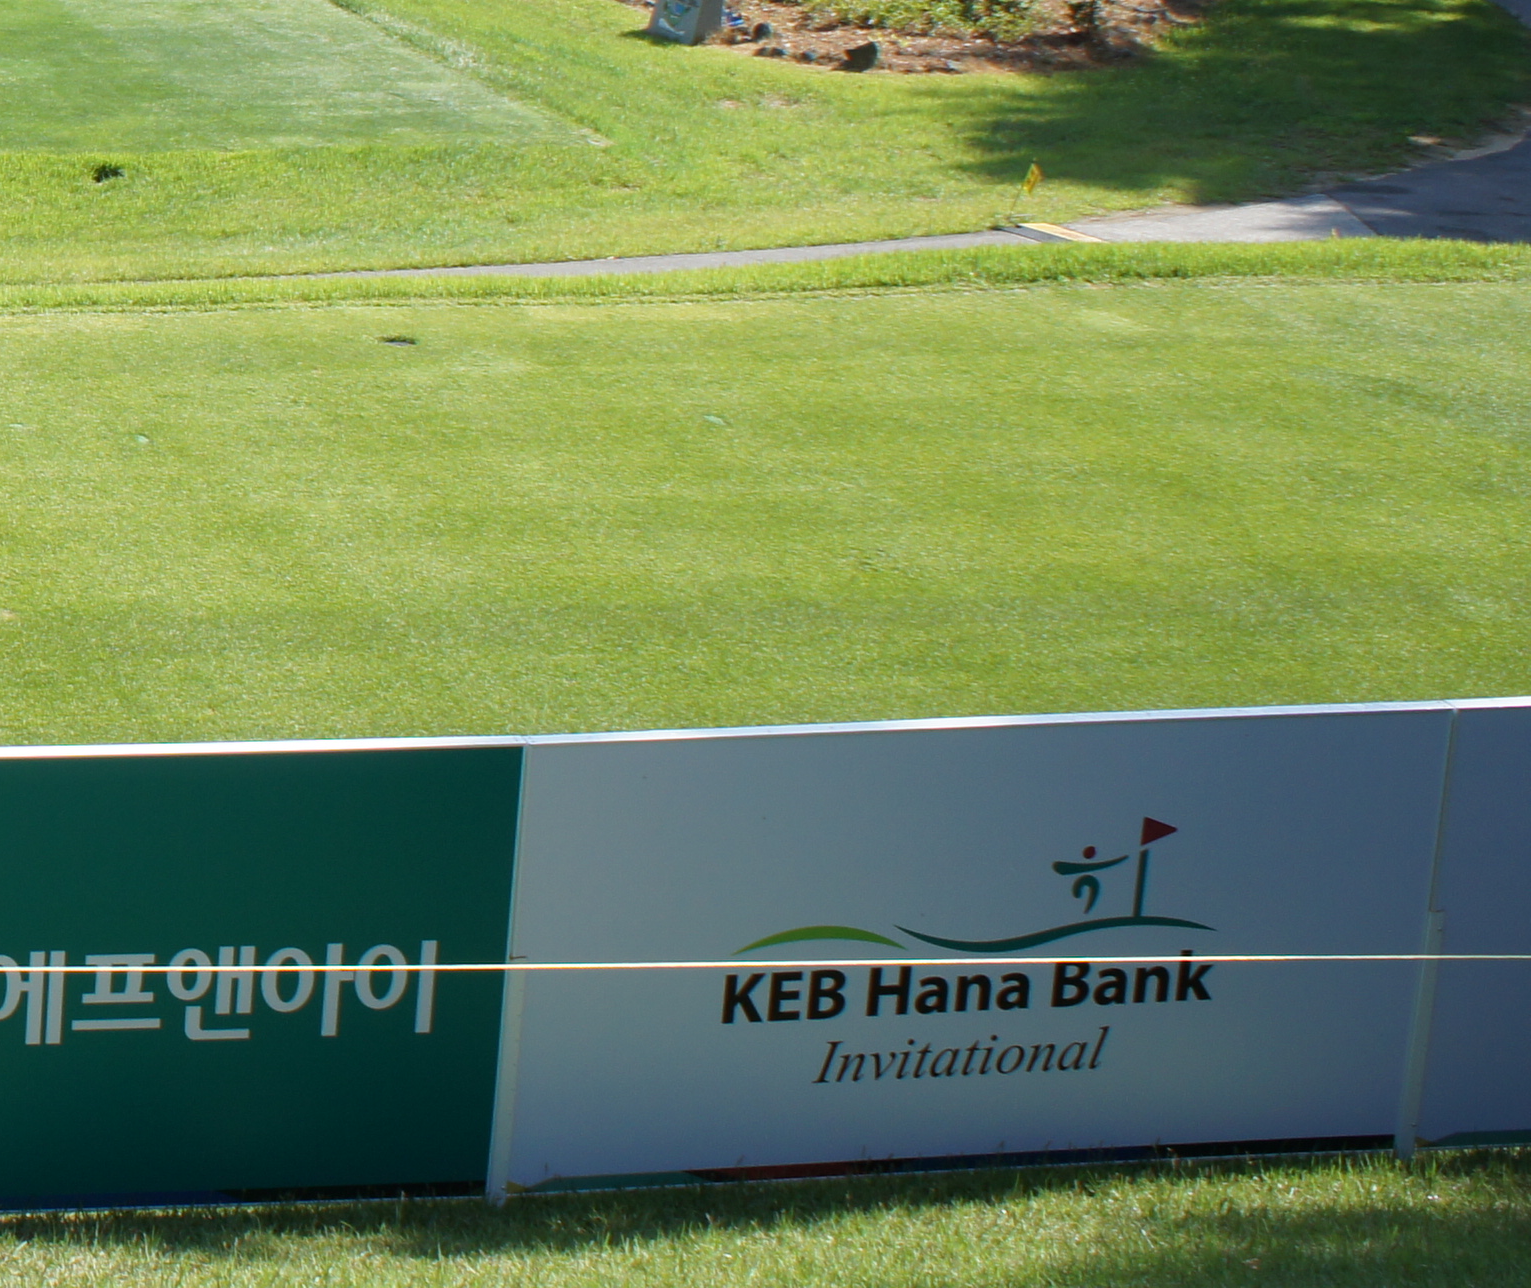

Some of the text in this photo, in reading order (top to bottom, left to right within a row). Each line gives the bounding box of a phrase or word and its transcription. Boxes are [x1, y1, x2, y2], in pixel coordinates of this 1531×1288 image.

[721, 949, 1215, 1025] KEB Hana Bank
[811, 1024, 1111, 1085] Invitational
